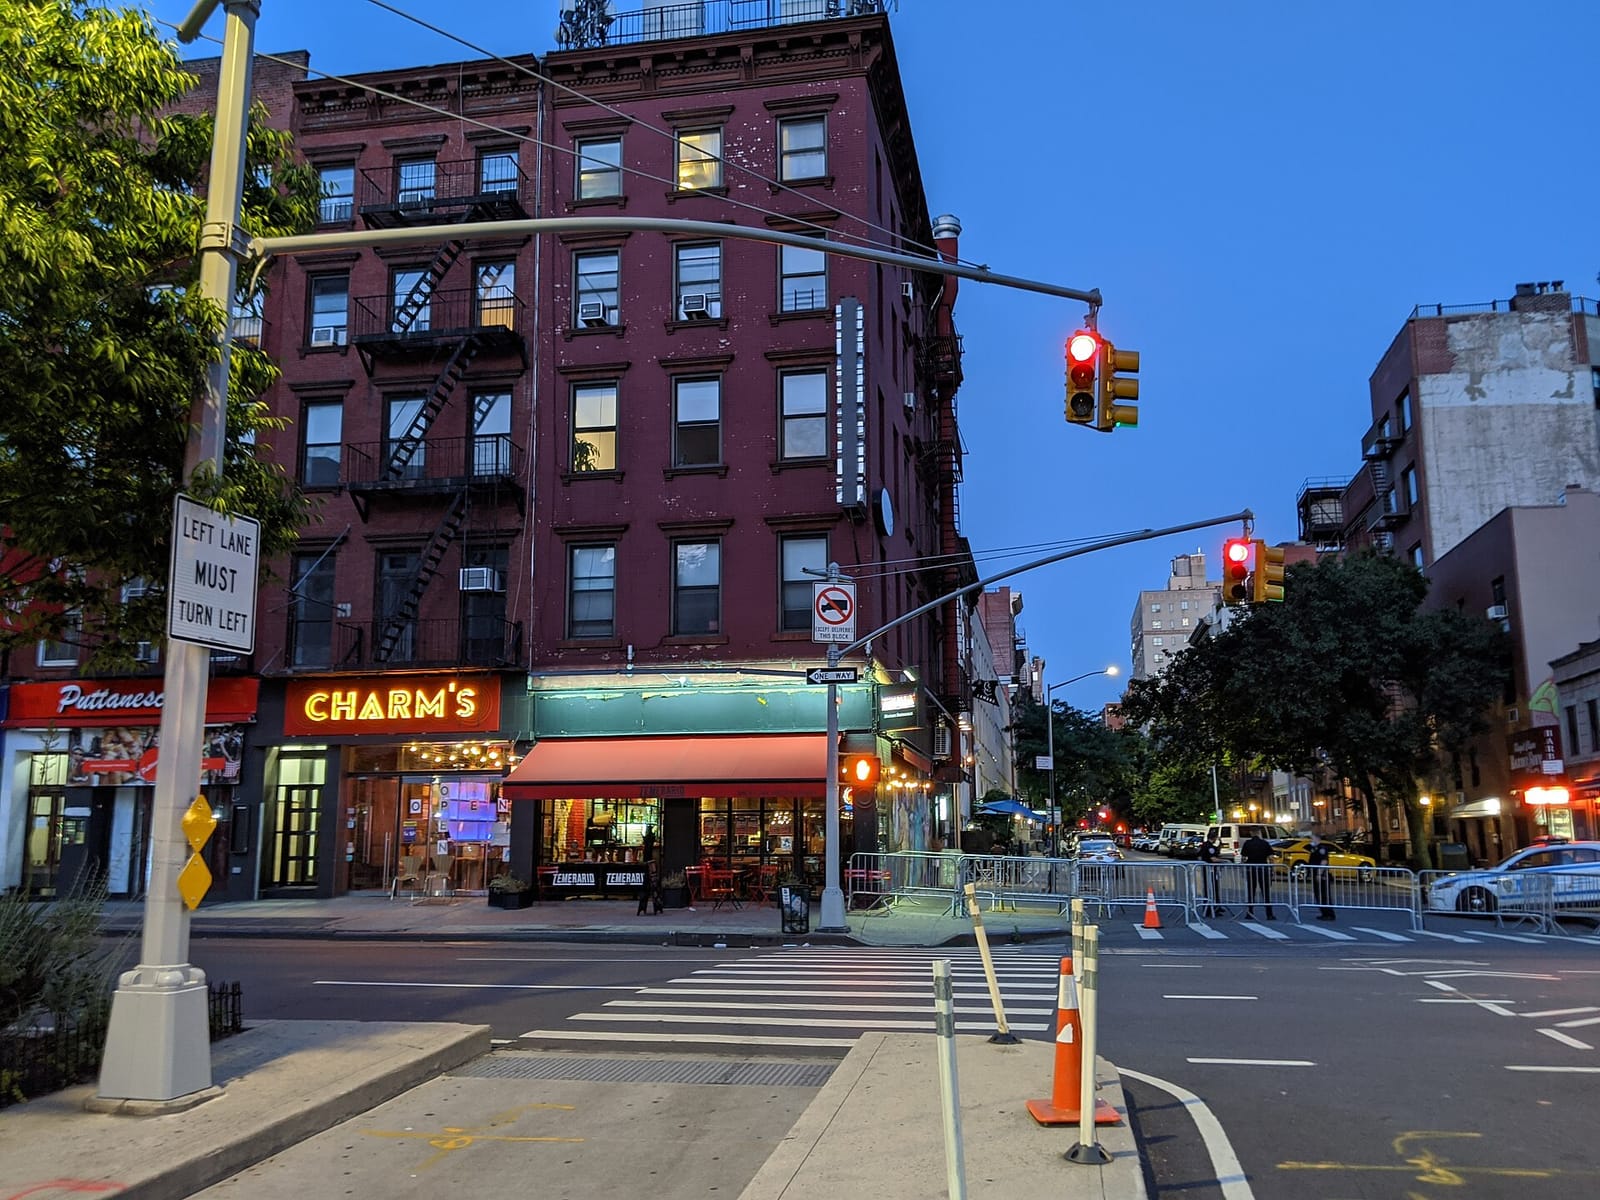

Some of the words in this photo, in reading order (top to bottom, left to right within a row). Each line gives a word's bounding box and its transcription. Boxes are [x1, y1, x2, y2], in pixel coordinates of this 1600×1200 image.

[183, 517, 214, 545] LEFT
[220, 528, 252, 556] LANE
[195, 560, 237, 593] MUST
[179, 600, 213, 626] TURN
[219, 608, 248, 633] LEFT
[814, 672, 829, 680] ONE
[835, 671, 852, 679] WAY
[58, 685, 165, 713] Puttanesc
[304, 681, 476, 722] CHARM'S
[552, 872, 596, 886] TEMERARIO
[606, 872, 645, 886] TEMERARI
